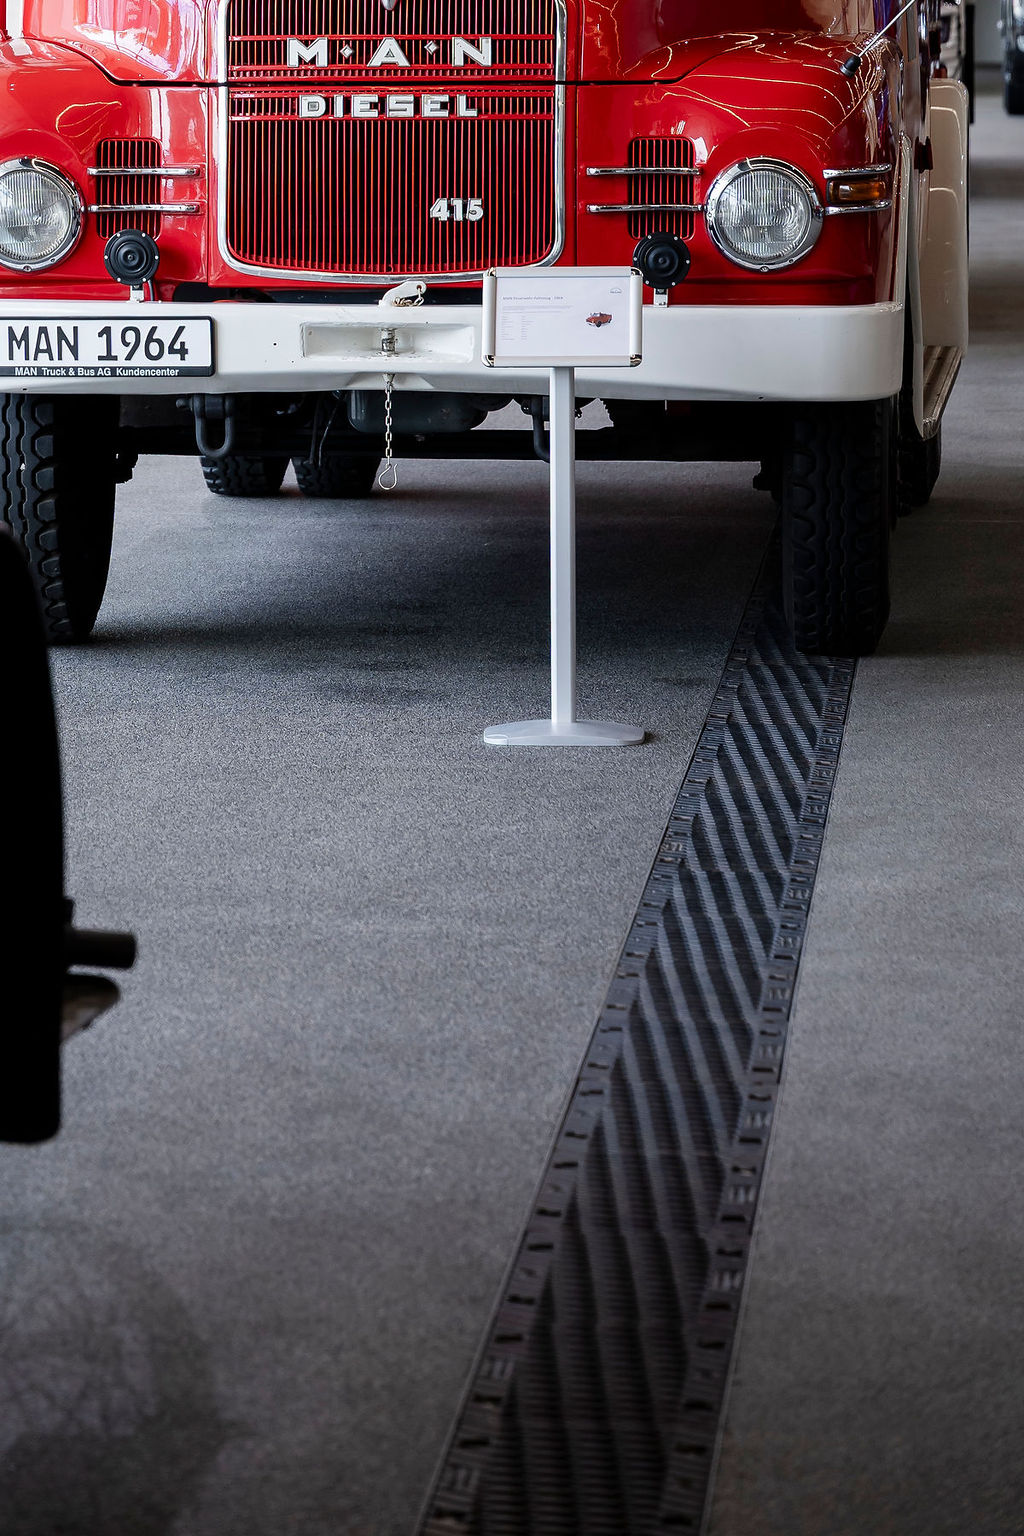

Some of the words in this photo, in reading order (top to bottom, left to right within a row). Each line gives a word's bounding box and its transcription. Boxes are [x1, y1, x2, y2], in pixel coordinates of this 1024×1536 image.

[299, 94, 479, 118] DIESEL
[429, 197, 484, 222] 415
[8, 325, 79, 361] MAN
[97, 325, 189, 361] 1964
[15, 366, 38, 376] MAN
[41, 366, 68, 376] Truck
[68, 366, 75, 376] &
[77, 366, 95, 376] Bus
[96, 366, 111, 376] AG
[116, 366, 179, 376] Kundencenter
